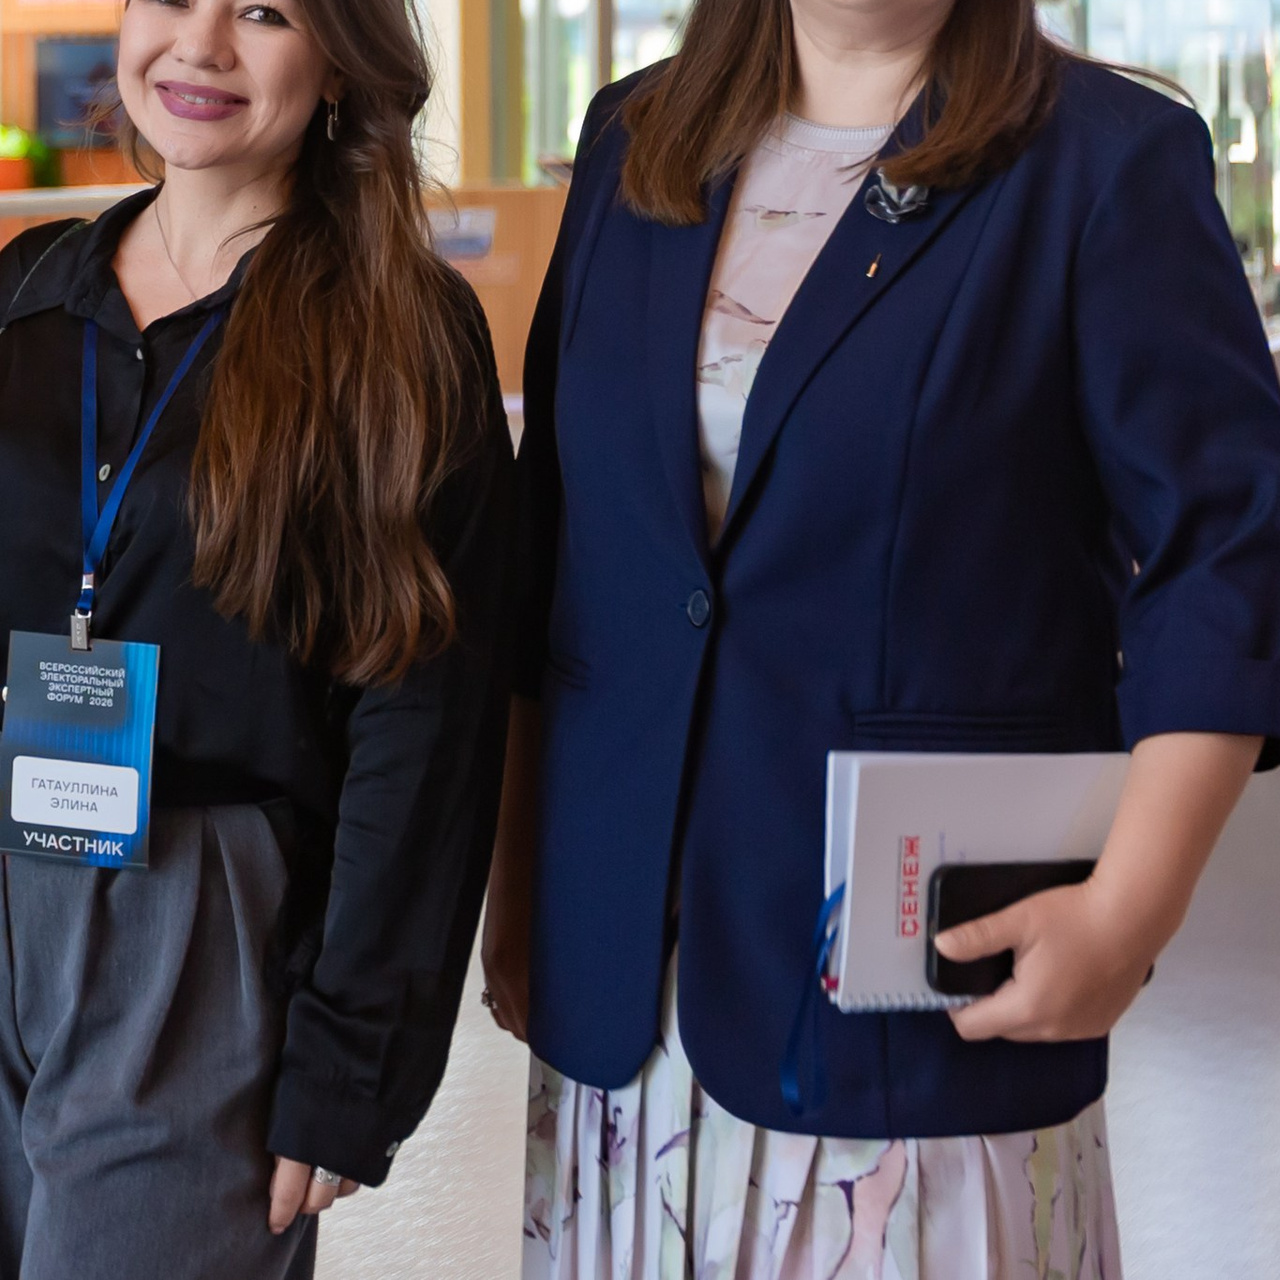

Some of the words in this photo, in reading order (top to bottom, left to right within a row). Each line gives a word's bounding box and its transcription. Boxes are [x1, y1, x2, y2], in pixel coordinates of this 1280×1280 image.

[39, 661, 126, 679] ВСЕРОССИЙСКИЙ
[40, 671, 124, 688] ЭЛЕКТОРАЛЬНЫЙ
[48, 682, 114, 697] ЭКСПЕРТНЫЙ
[47, 693, 83, 705] ФОРУМ
[89, 697, 114, 708] 2026
[31, 778, 119, 798] ГАТАУЛЛИНА
[50, 797, 99, 813] ЭЛИНА
[23, 830, 124, 857] УЧАСТНИК
[901, 835, 920, 938] СЕНЕЖ
